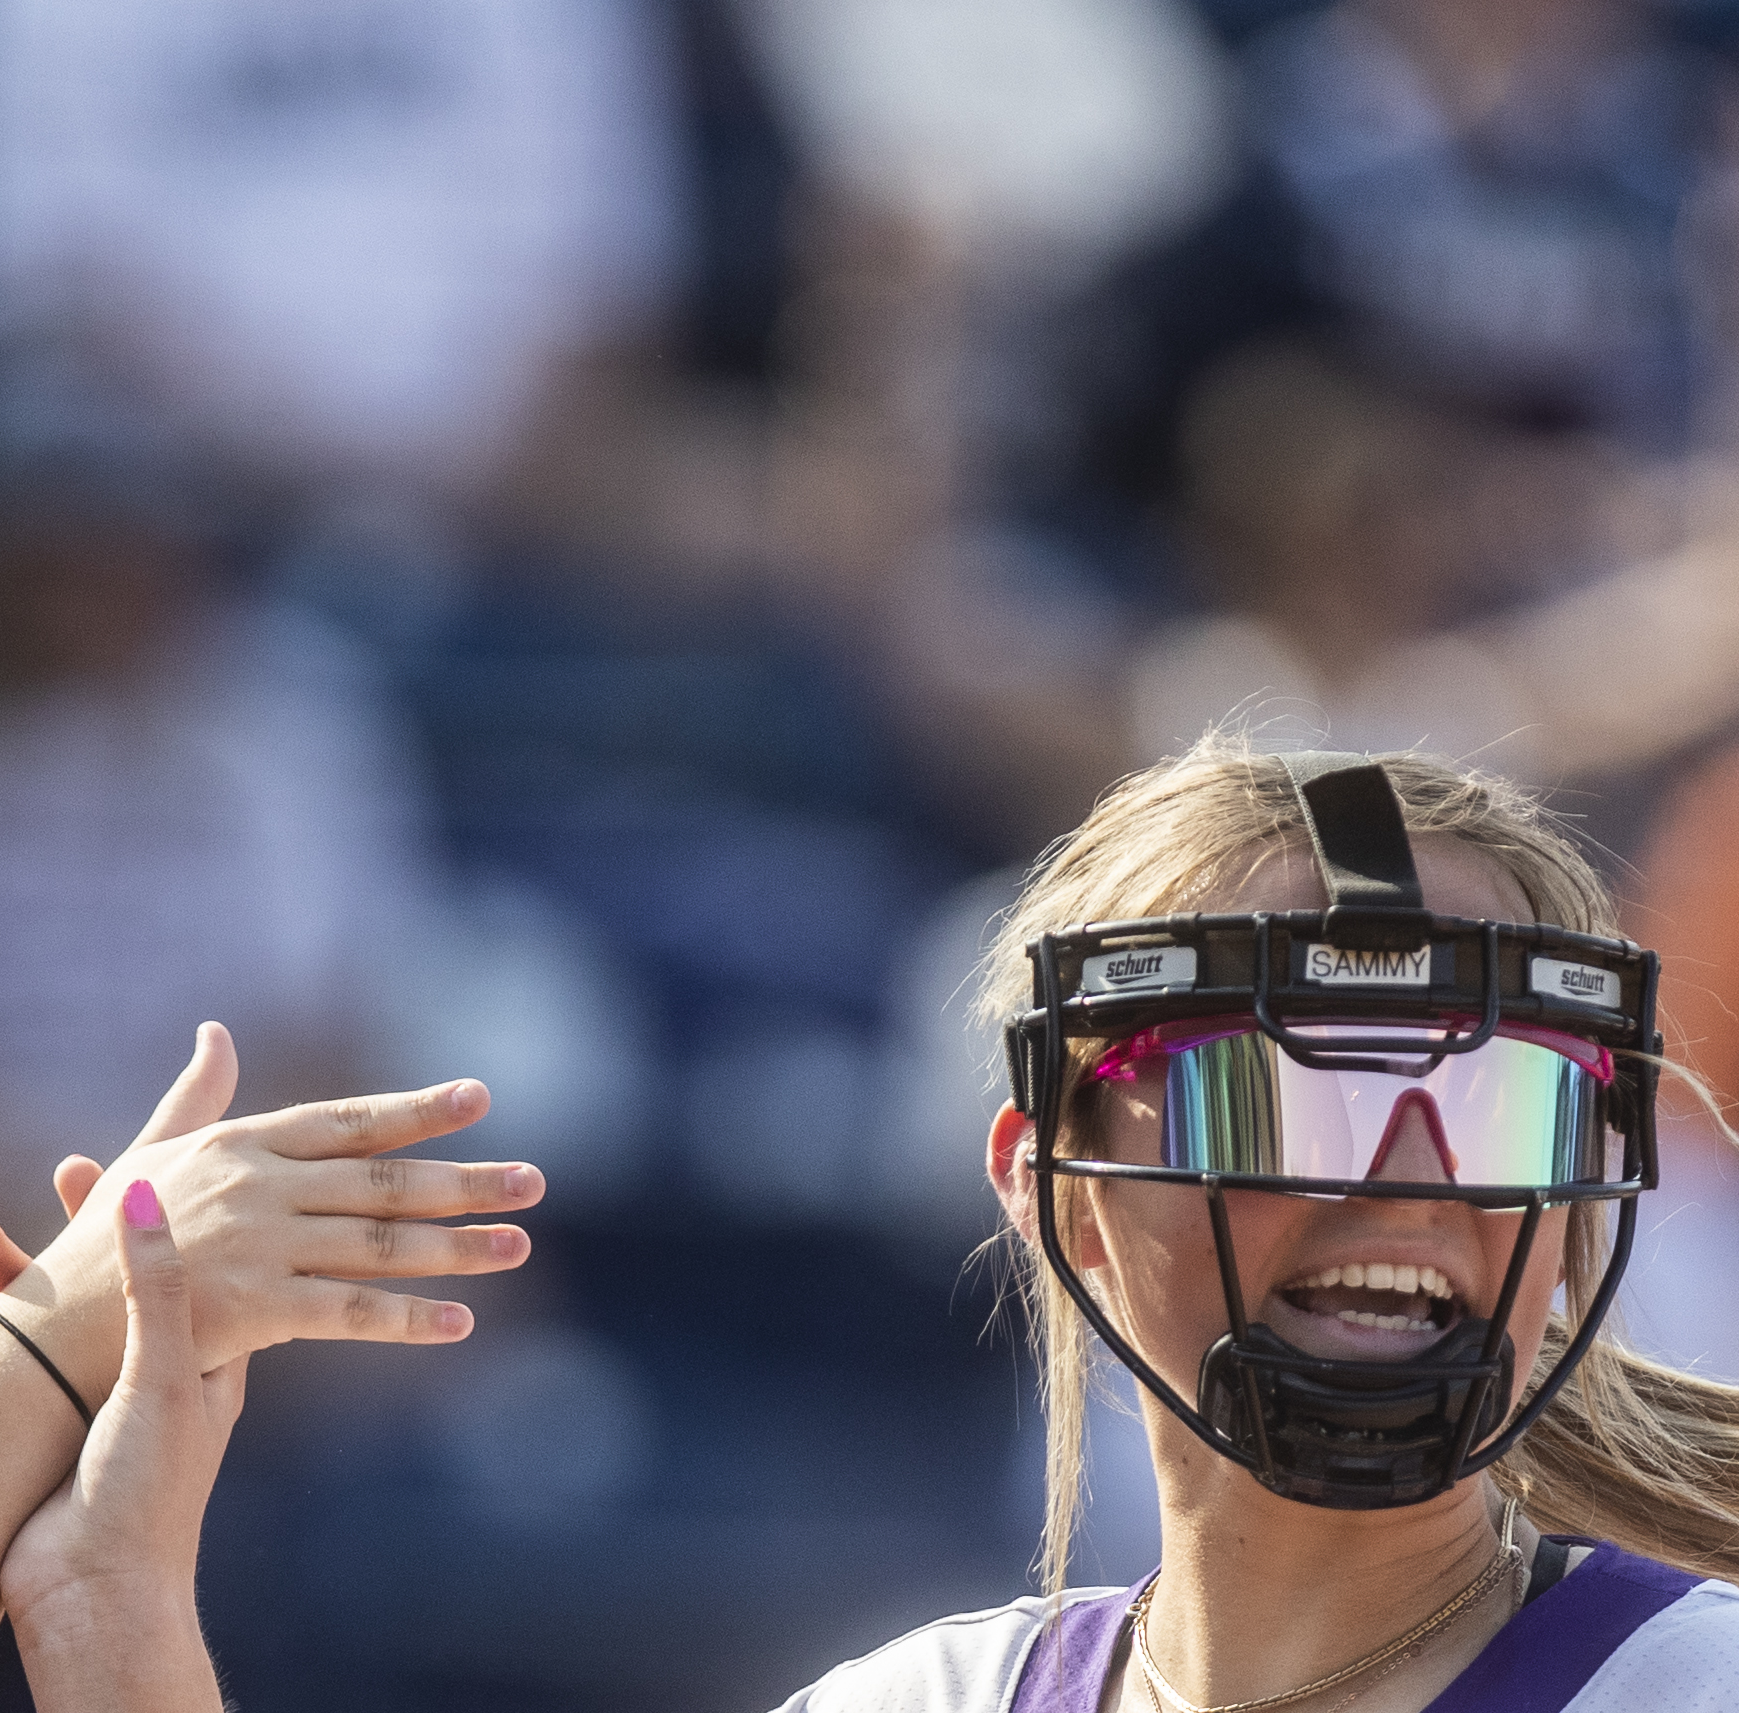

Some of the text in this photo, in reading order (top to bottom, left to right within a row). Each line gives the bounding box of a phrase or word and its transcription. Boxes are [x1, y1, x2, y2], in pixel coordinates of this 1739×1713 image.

[1105, 952, 1164, 979] schutt
[1312, 950, 1427, 978] SAMMY
[1560, 965, 1605, 993] schutt
